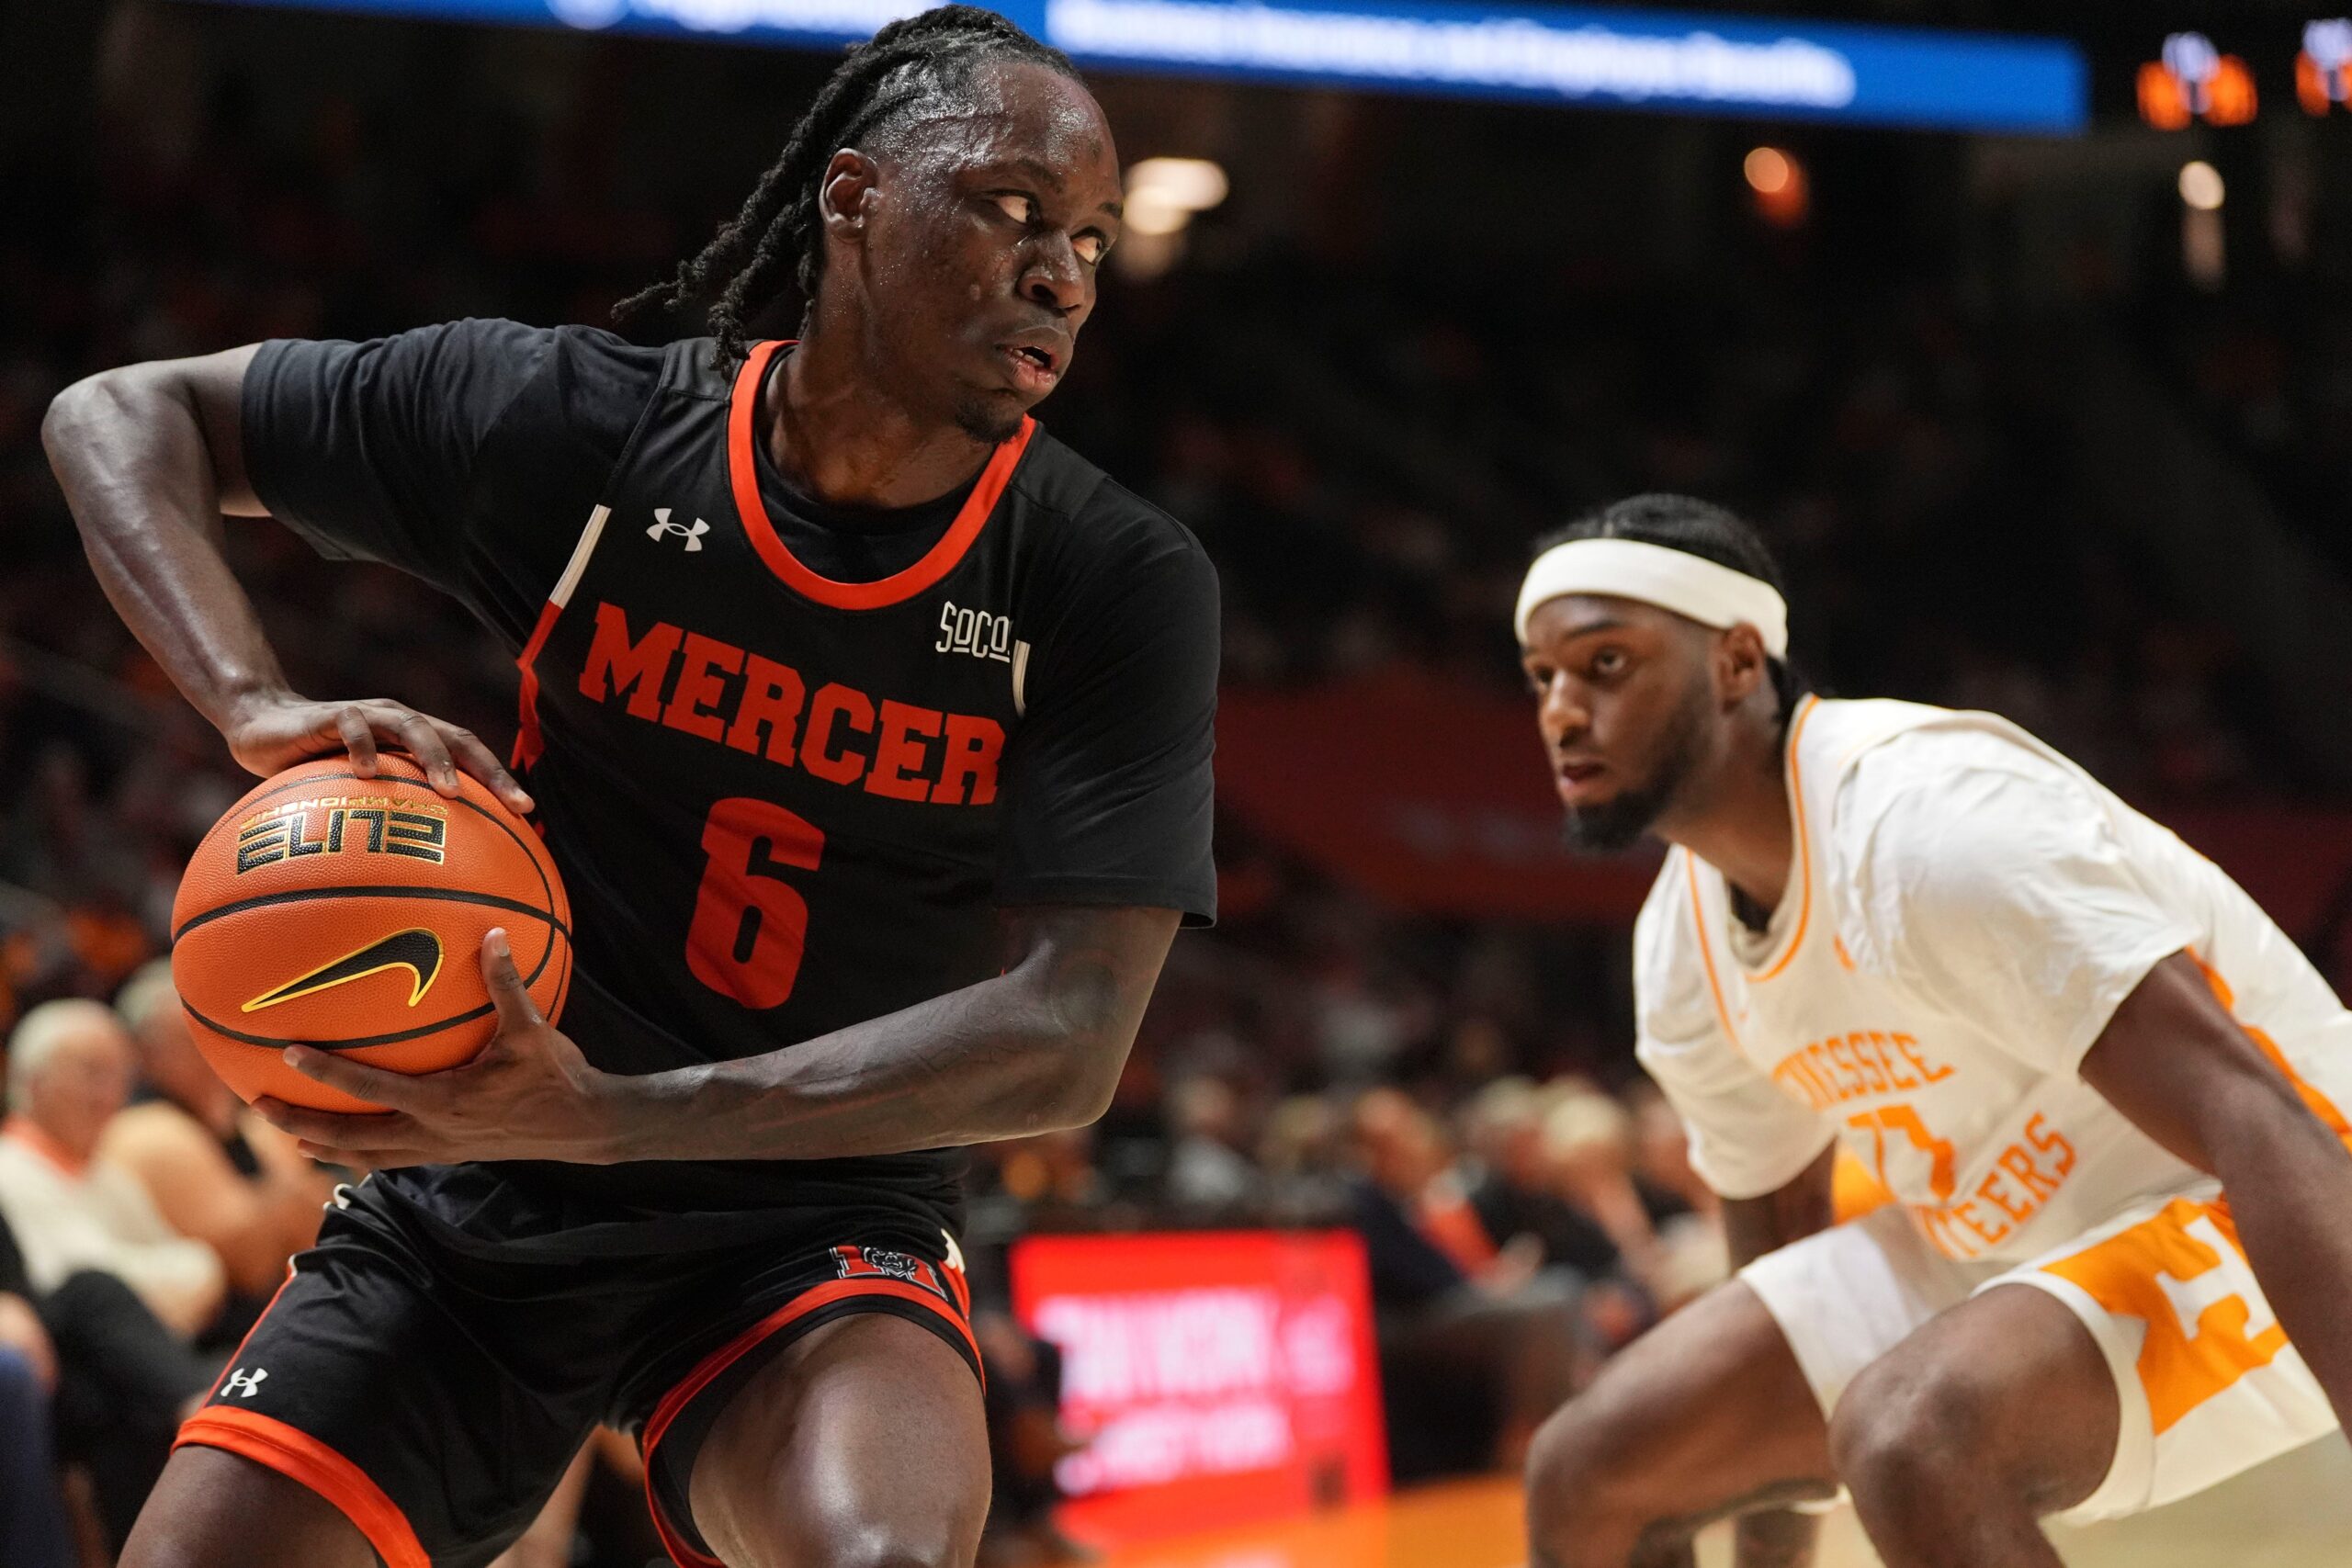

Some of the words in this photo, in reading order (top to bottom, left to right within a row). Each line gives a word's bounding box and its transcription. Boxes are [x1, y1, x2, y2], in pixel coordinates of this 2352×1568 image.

[935, 600, 1013, 663] SOCO
[579, 602, 1006, 806] MERCER
[236, 807, 447, 875] ELITE
[684, 796, 826, 1010] 6
